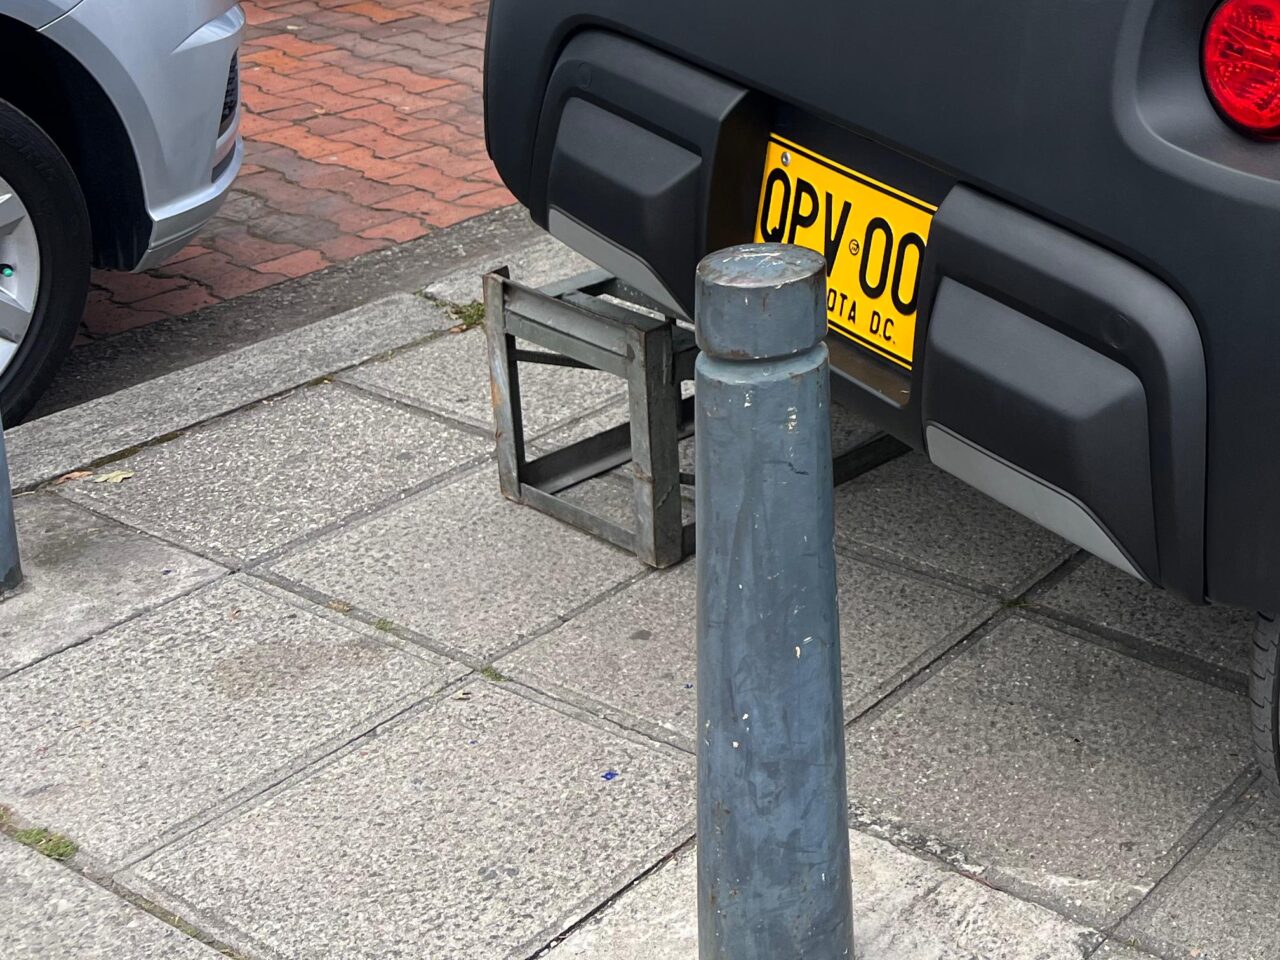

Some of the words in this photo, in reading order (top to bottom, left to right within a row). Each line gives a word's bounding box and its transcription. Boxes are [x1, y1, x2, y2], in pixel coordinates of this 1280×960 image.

[760, 167, 852, 278] QPV
[826, 289, 857, 324] OTA
[869, 310, 896, 345] D.C.
